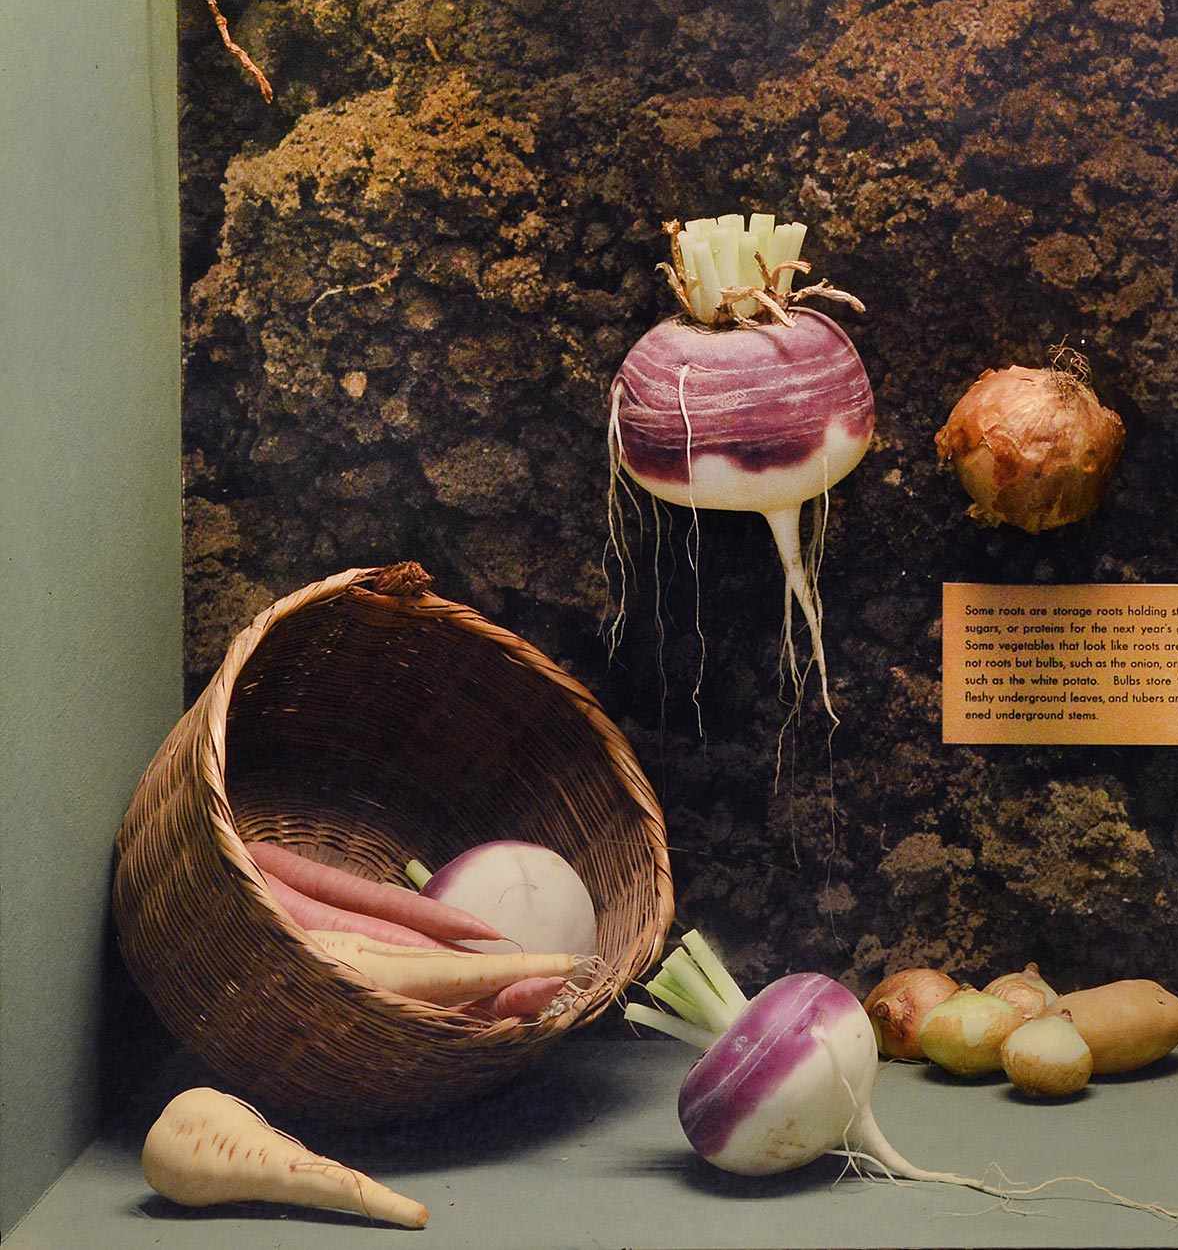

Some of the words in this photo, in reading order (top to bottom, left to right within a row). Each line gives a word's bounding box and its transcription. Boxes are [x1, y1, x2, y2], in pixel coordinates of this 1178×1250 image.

[965, 605, 994, 615] Some
[999, 607, 1025, 615] roots
[1053, 608, 1092, 617] storage
[1128, 605, 1167, 618] holding
[965, 659, 981, 667] not
[1016, 657, 1032, 668] but
[1036, 657, 1065, 669] bulbs,
[1070, 657, 1092, 668] such
[1111, 657, 1126, 668] the
[1131, 661, 1162, 669] onion,
[965, 674, 988, 685] such
[1010, 674, 1025, 685] the
[1031, 674, 1058, 685] white
[1063, 677, 1099, 686] potato.
[1114, 675, 1140, 685] Bulbs
[965, 691, 994, 704] fleshy
[999, 692, 1066, 704] underground
[1071, 692, 1105, 704] leaves,
[1108, 692, 1128, 702] and
[1133, 692, 1164, 703] tubers
[965, 709, 991, 719] ened
[996, 709, 1063, 721] underground
[1069, 712, 1098, 720] stems.
